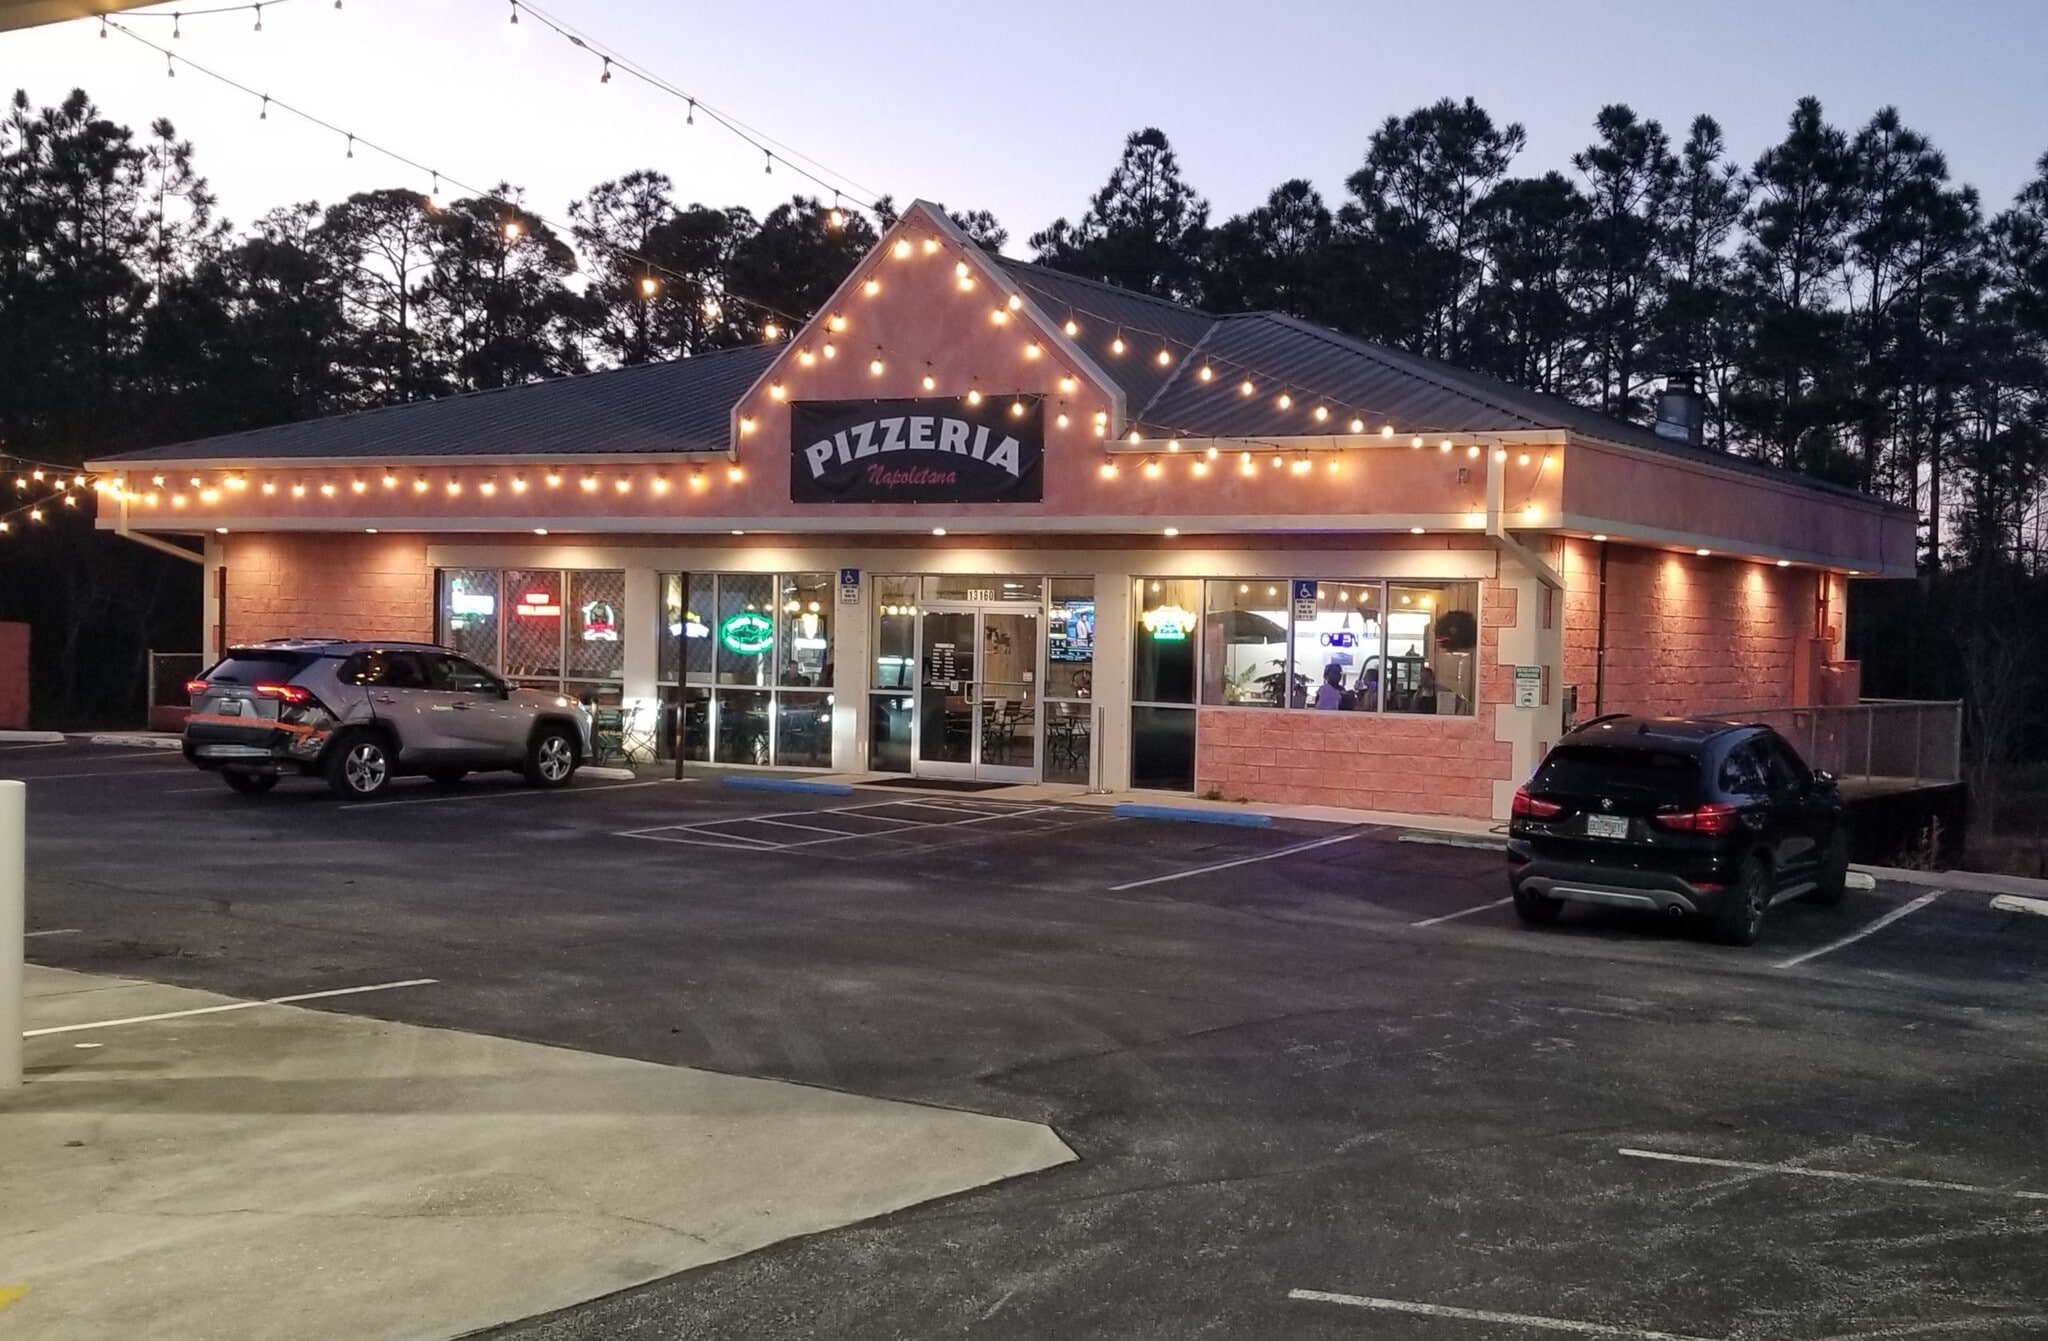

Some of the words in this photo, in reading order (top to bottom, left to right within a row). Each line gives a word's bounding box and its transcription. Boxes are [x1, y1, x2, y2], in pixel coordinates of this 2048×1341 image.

[804, 416, 1021, 479] PIZZERIA
[867, 463, 957, 489] Napoletana
[969, 590, 994, 601] 13160
